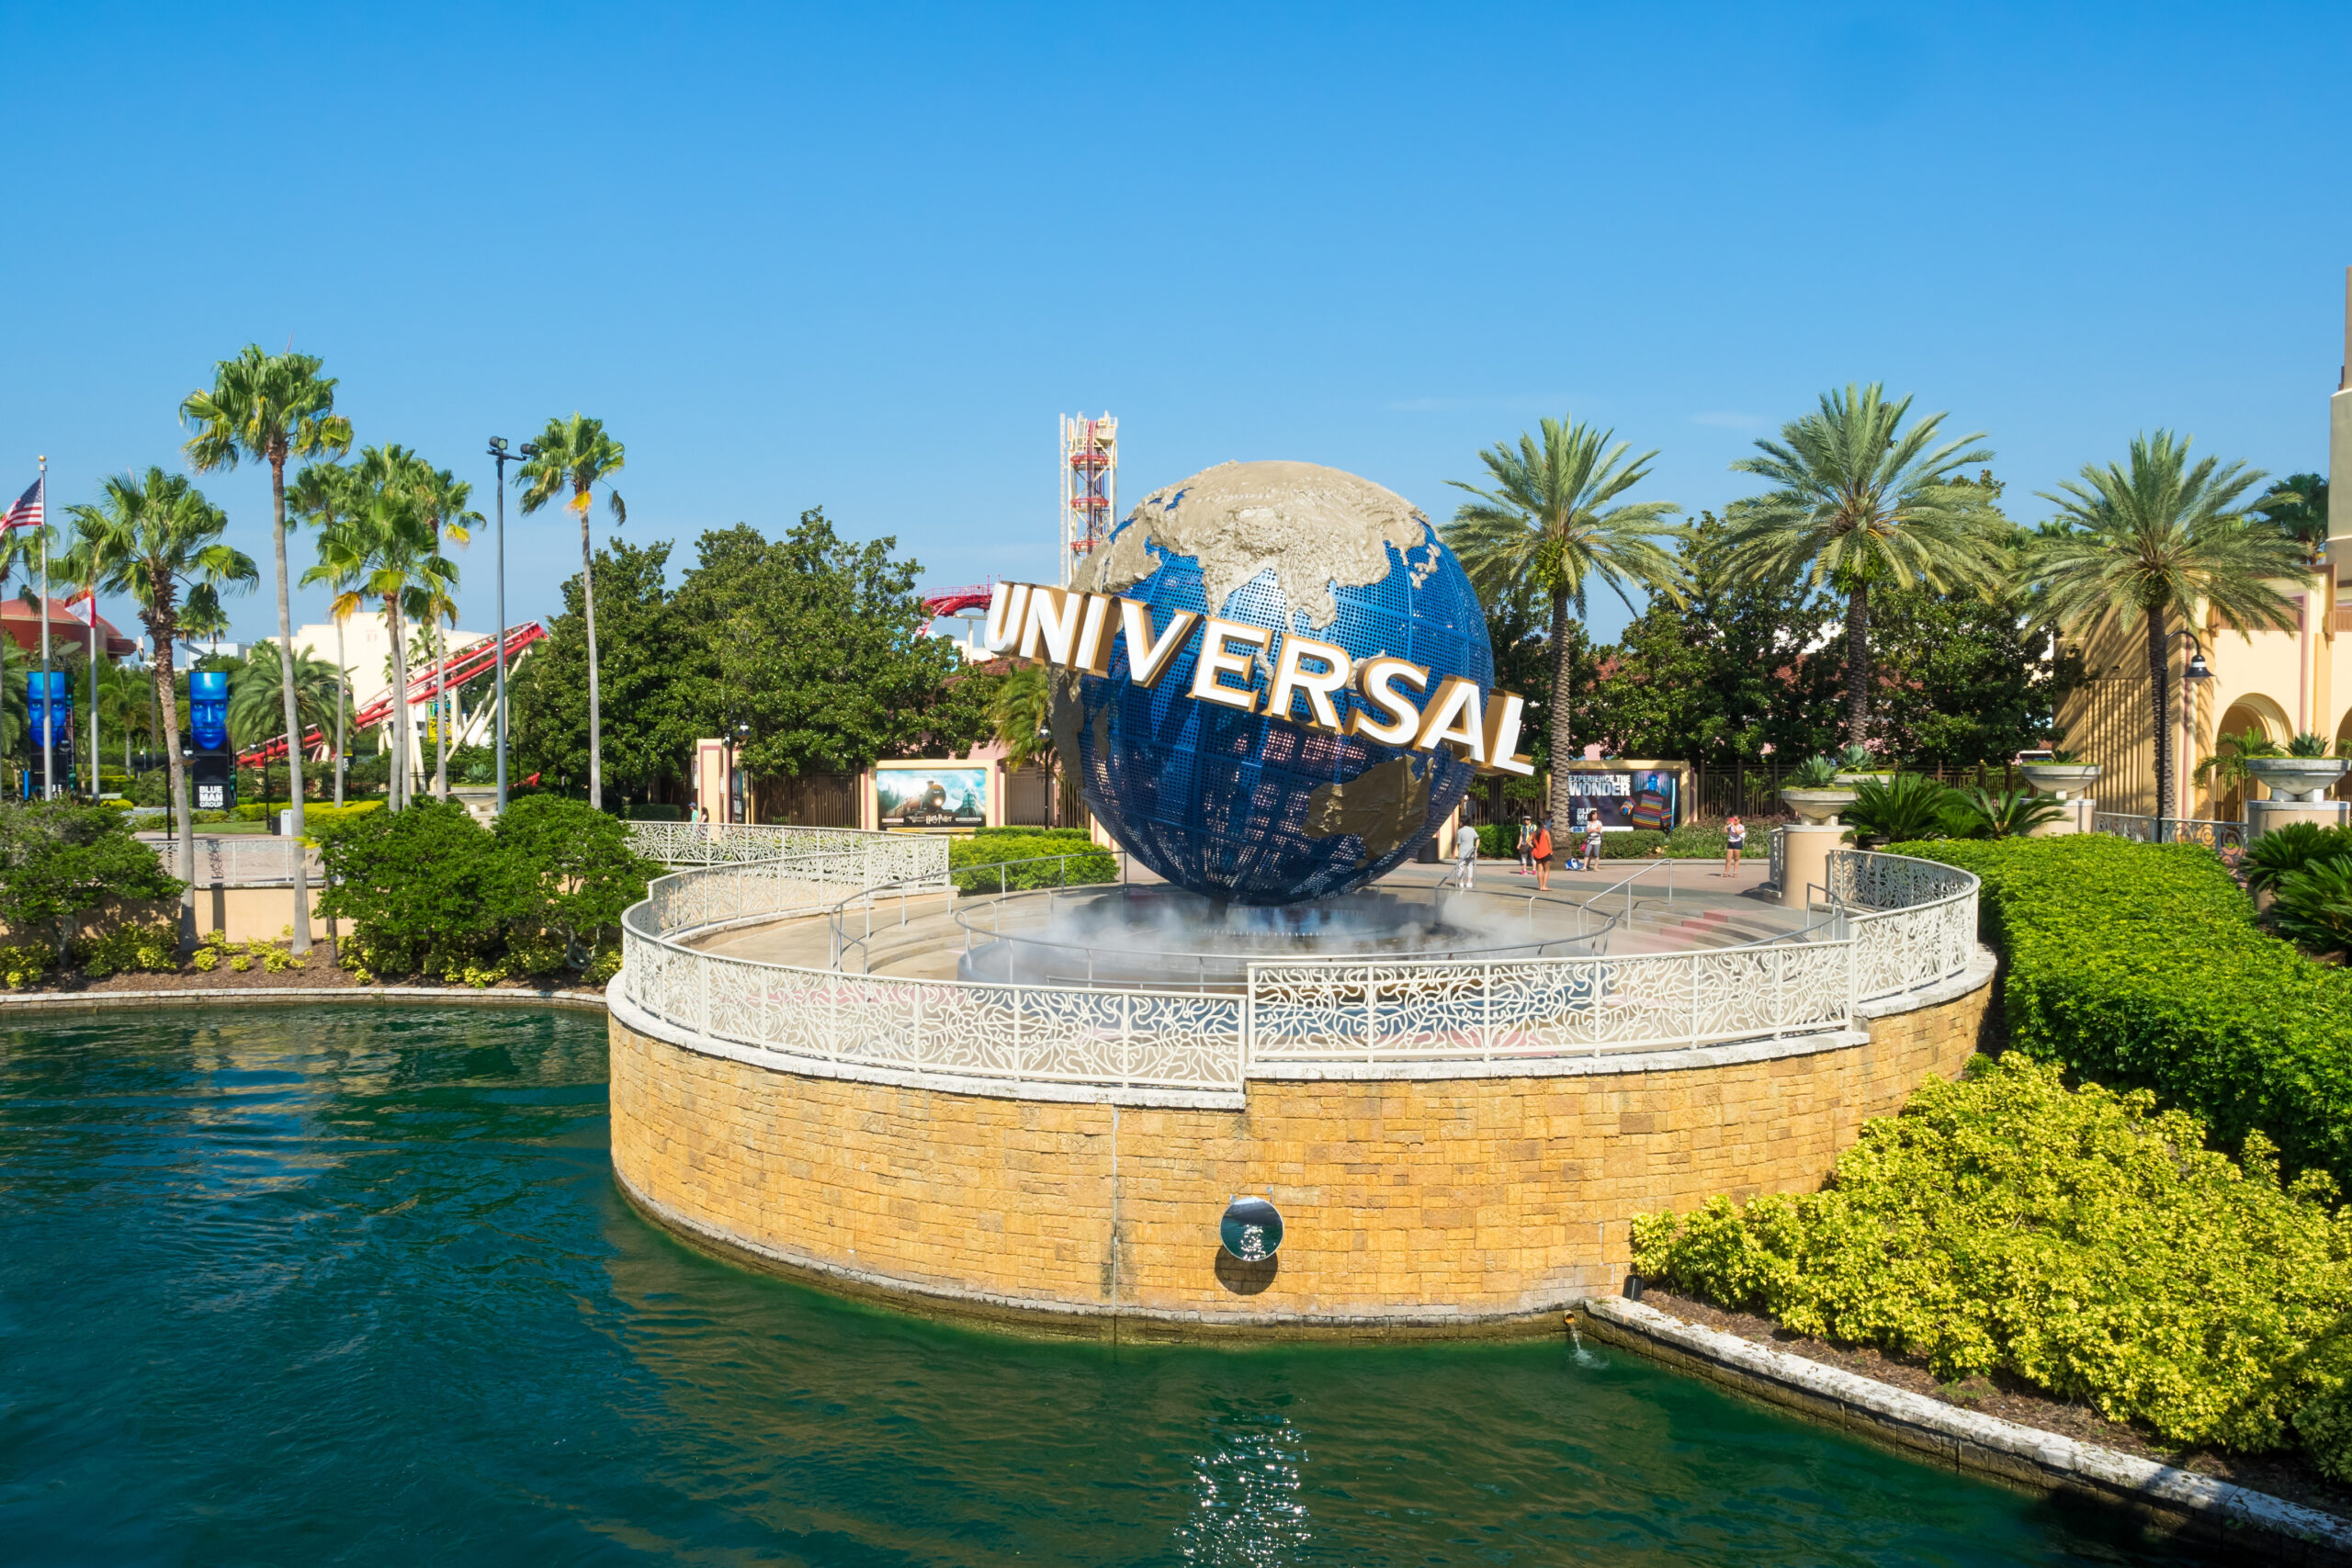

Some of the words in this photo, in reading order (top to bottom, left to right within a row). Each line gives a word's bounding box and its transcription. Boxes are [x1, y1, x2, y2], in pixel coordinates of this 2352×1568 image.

[984, 581, 1535, 777] UNIVERSAL
[1568, 774, 1614, 783] EXPERIENCE
[1616, 774, 1631, 783] THE
[1568, 783, 1631, 796] WONDER
